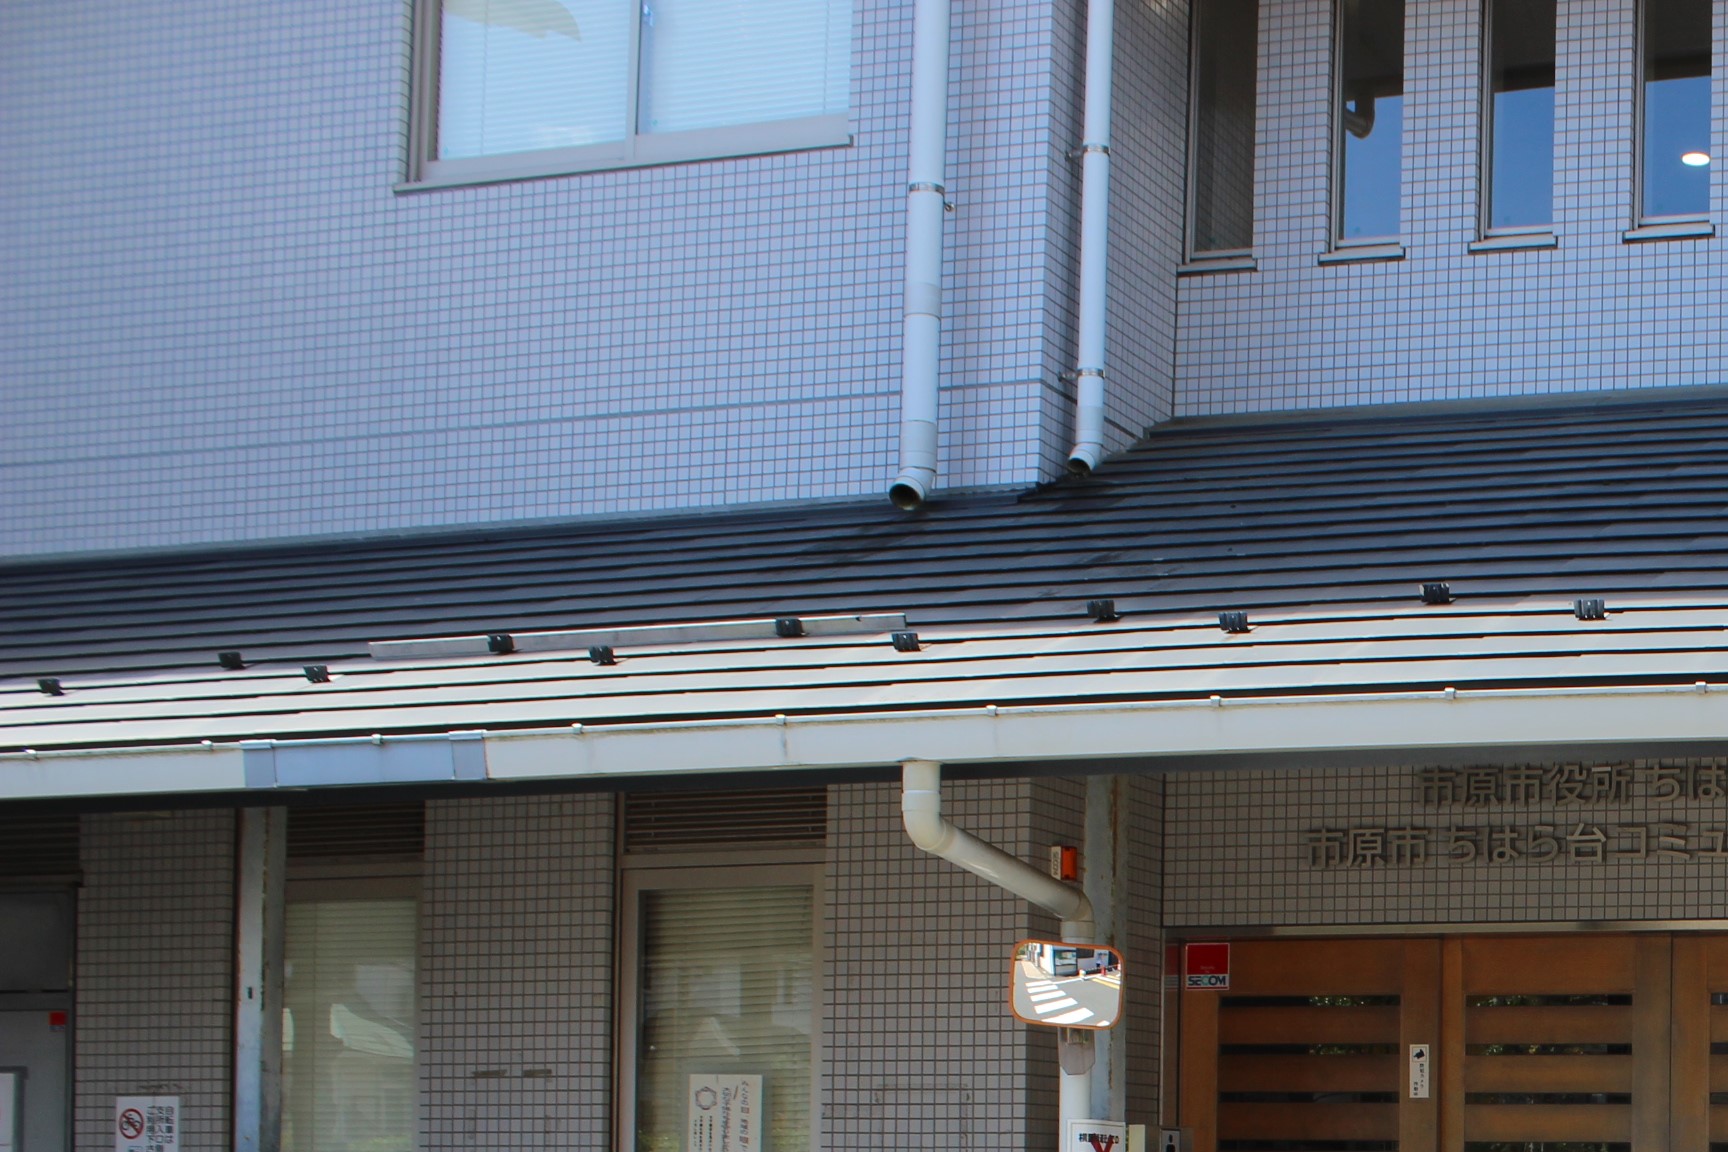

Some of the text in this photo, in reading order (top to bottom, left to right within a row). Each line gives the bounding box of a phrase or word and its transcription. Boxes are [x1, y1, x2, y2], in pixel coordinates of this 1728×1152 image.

[1416, 764, 1632, 806] 市原市役所
[1305, 827, 1428, 868] 市原市
[1188, 975, 1226, 986] SECOM
